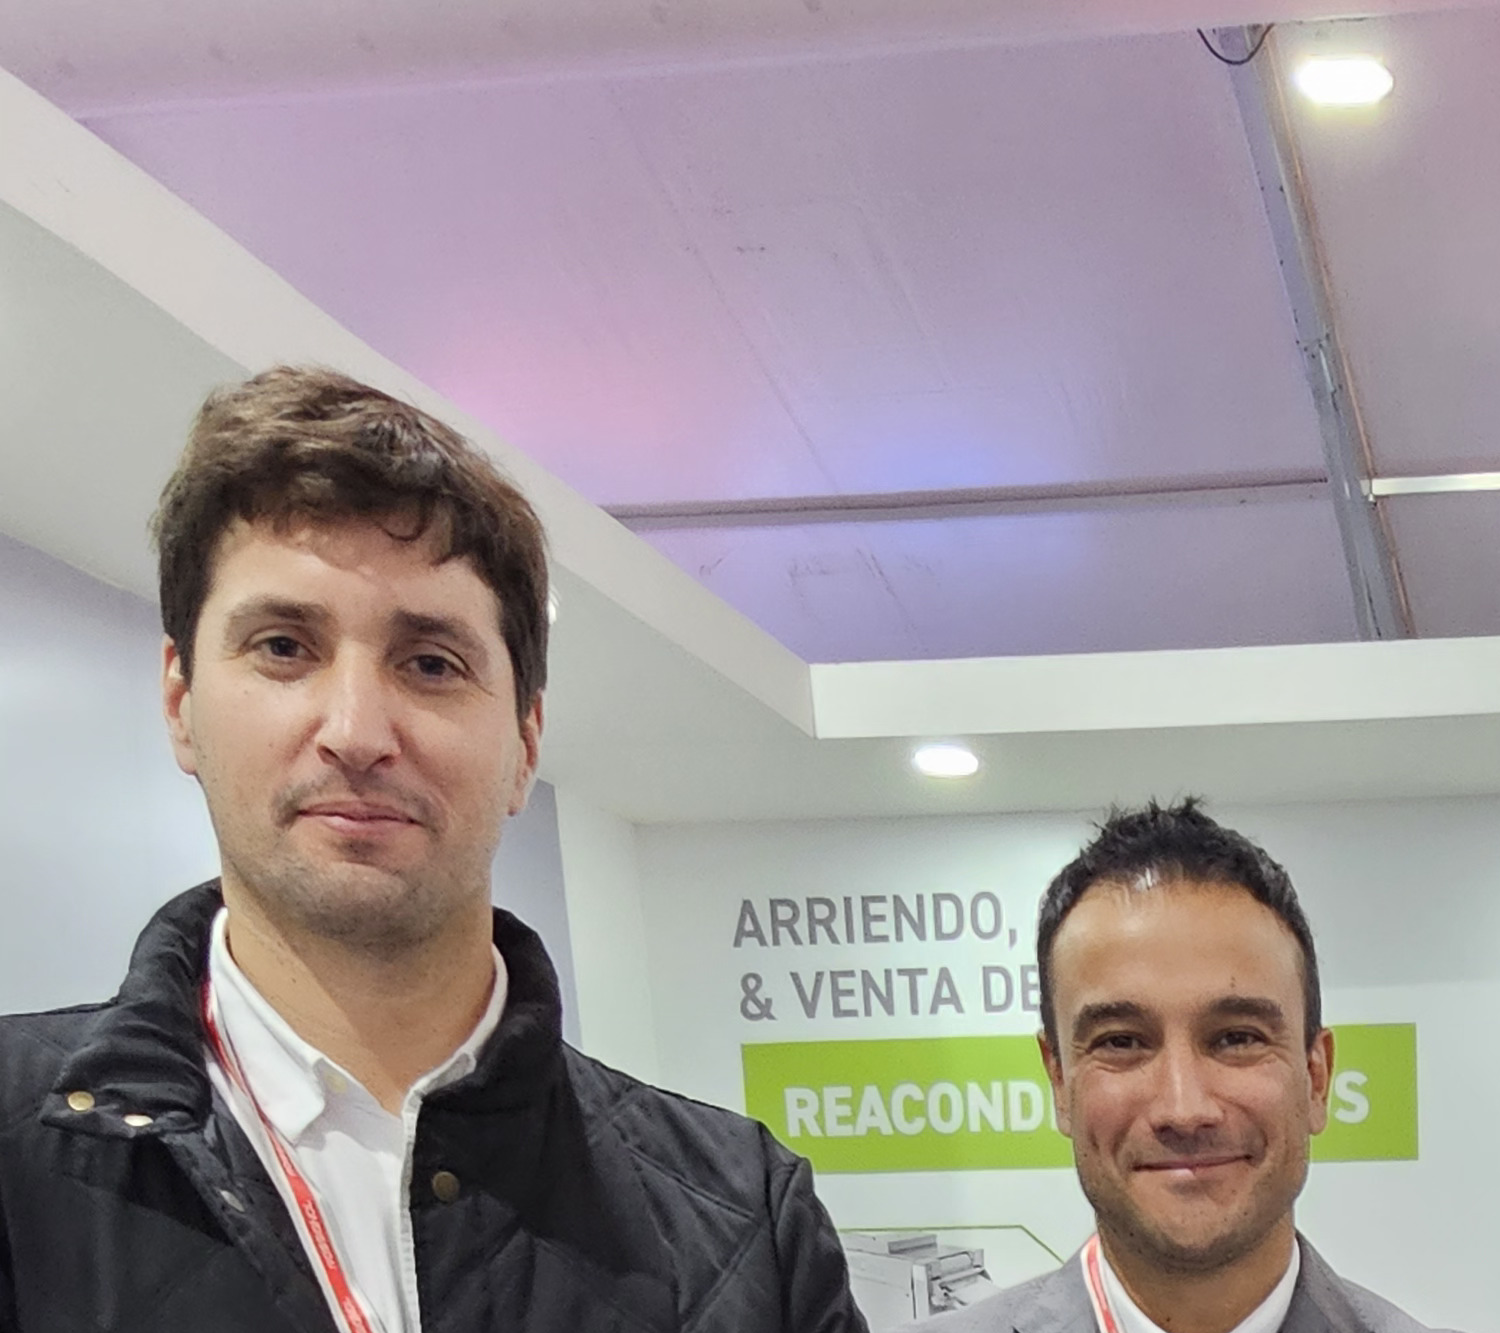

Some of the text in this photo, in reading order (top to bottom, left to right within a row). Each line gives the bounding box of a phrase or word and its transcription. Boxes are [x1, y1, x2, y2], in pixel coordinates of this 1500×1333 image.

[733, 891, 1017, 949] ARRIENDO,
[739, 964, 1039, 1022] & VENTA DE
